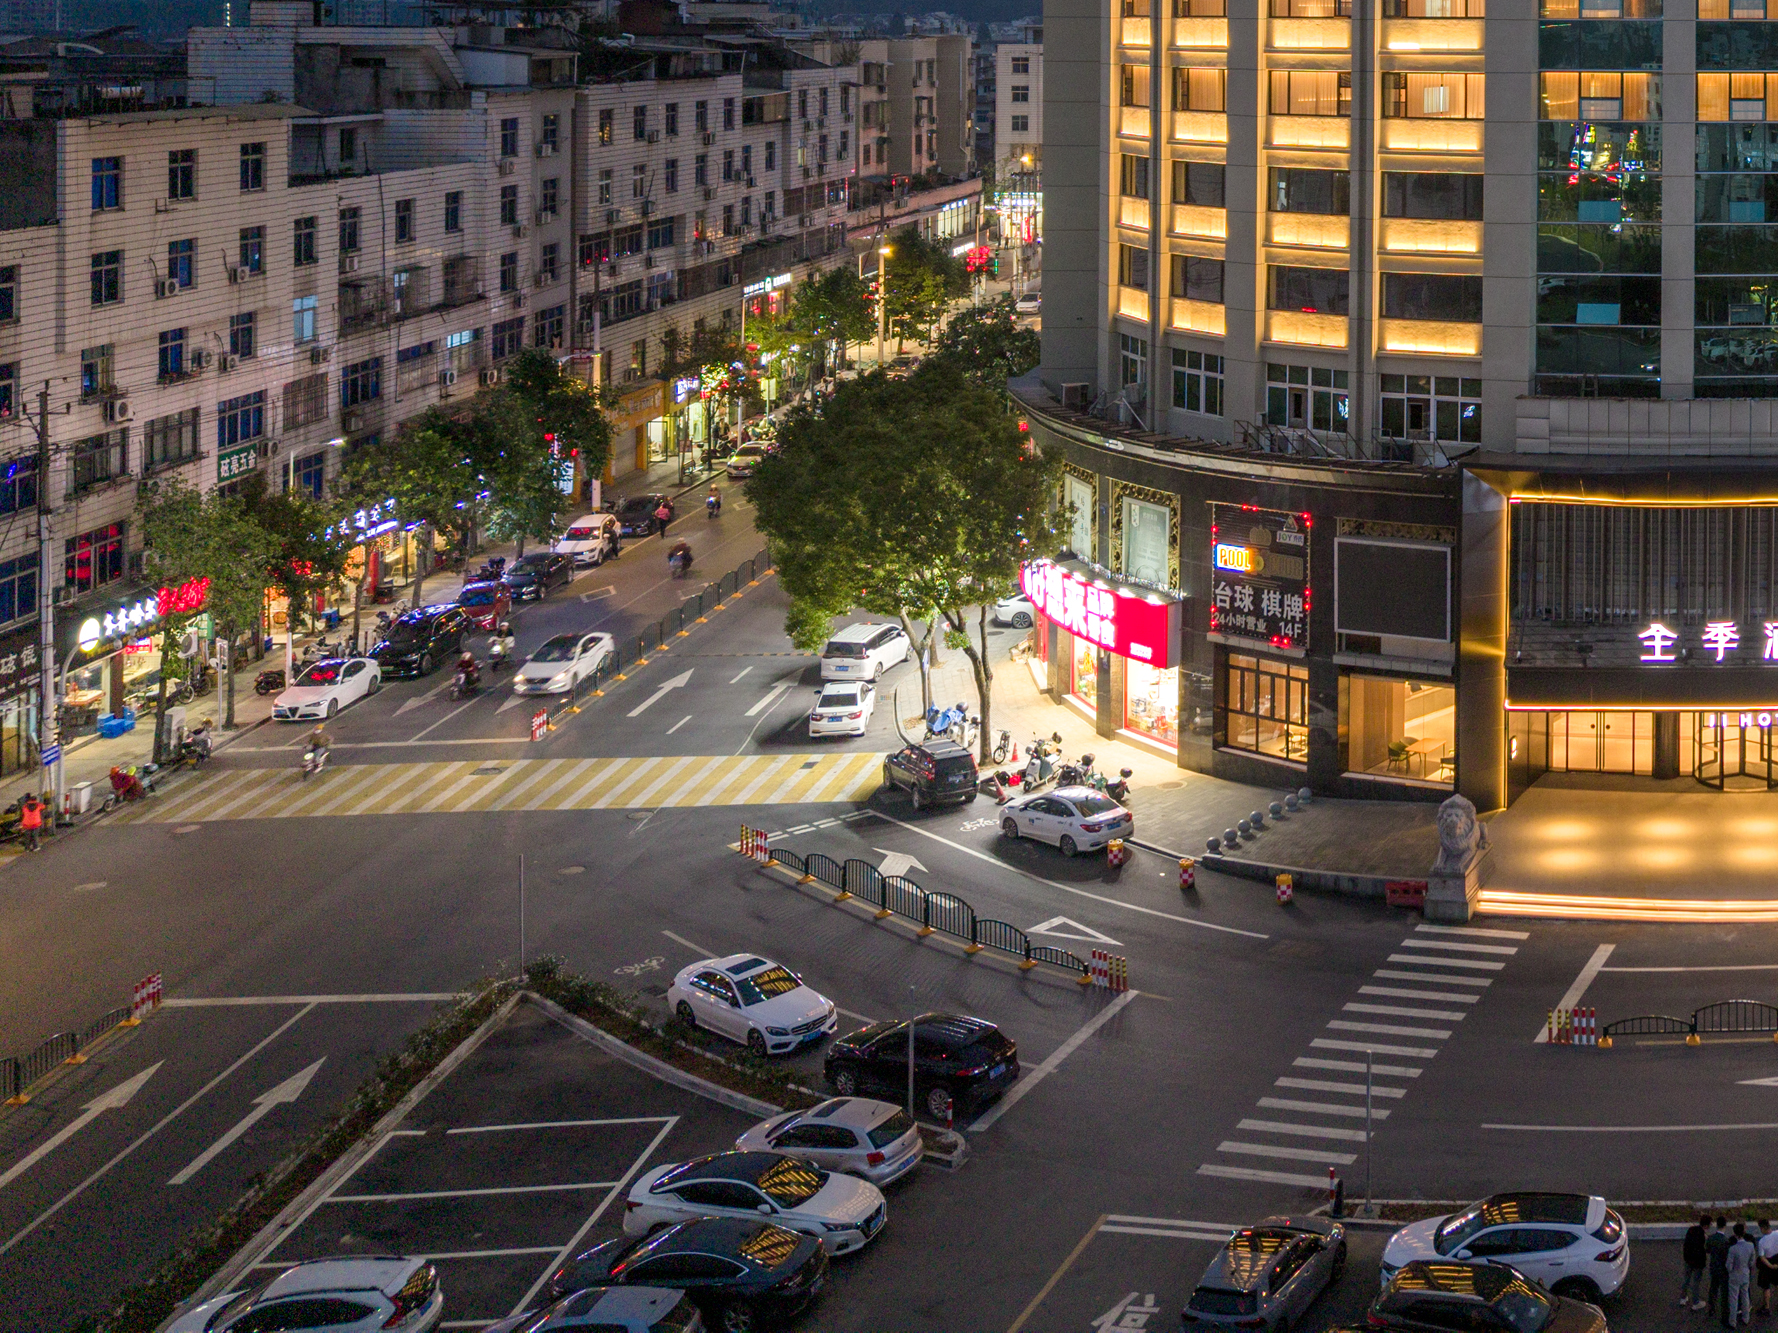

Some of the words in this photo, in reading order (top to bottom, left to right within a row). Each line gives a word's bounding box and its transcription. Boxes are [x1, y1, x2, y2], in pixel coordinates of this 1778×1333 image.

[1219, 547, 1251, 571] POOL
[1215, 581, 1254, 613] 台球
[1261, 589, 1304, 622] 棋牌
[1213, 612, 1267, 633] 24小时营业
[1279, 621, 1302, 639] 14F
